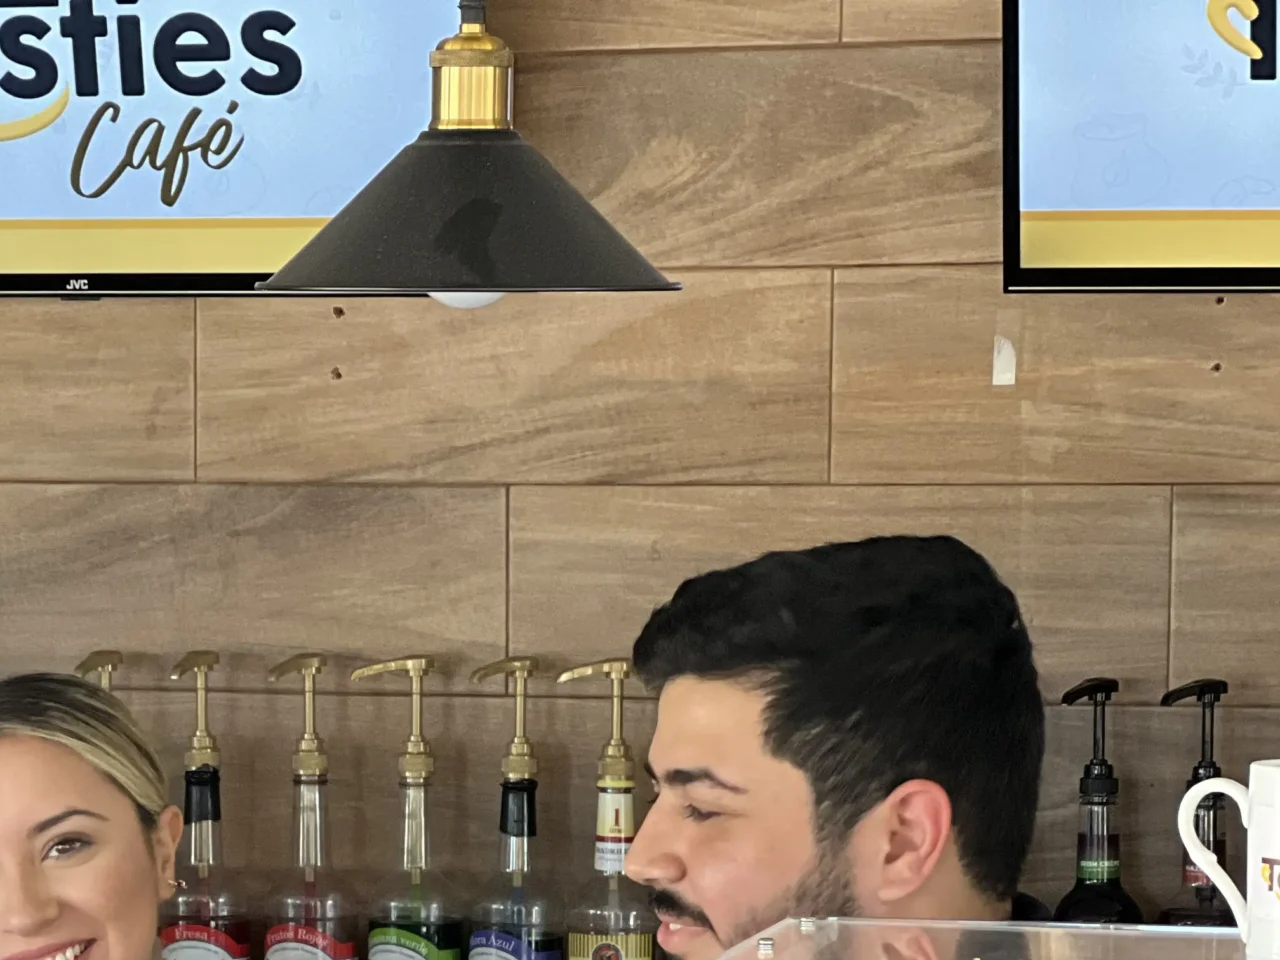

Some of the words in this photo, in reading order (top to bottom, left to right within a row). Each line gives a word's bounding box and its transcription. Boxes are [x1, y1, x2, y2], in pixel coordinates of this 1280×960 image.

[70, 99, 245, 207] Café
[66, 279, 89, 289] JVC
[174, 927, 208, 940] Fresa
[297, 928, 329, 947] Rojos
